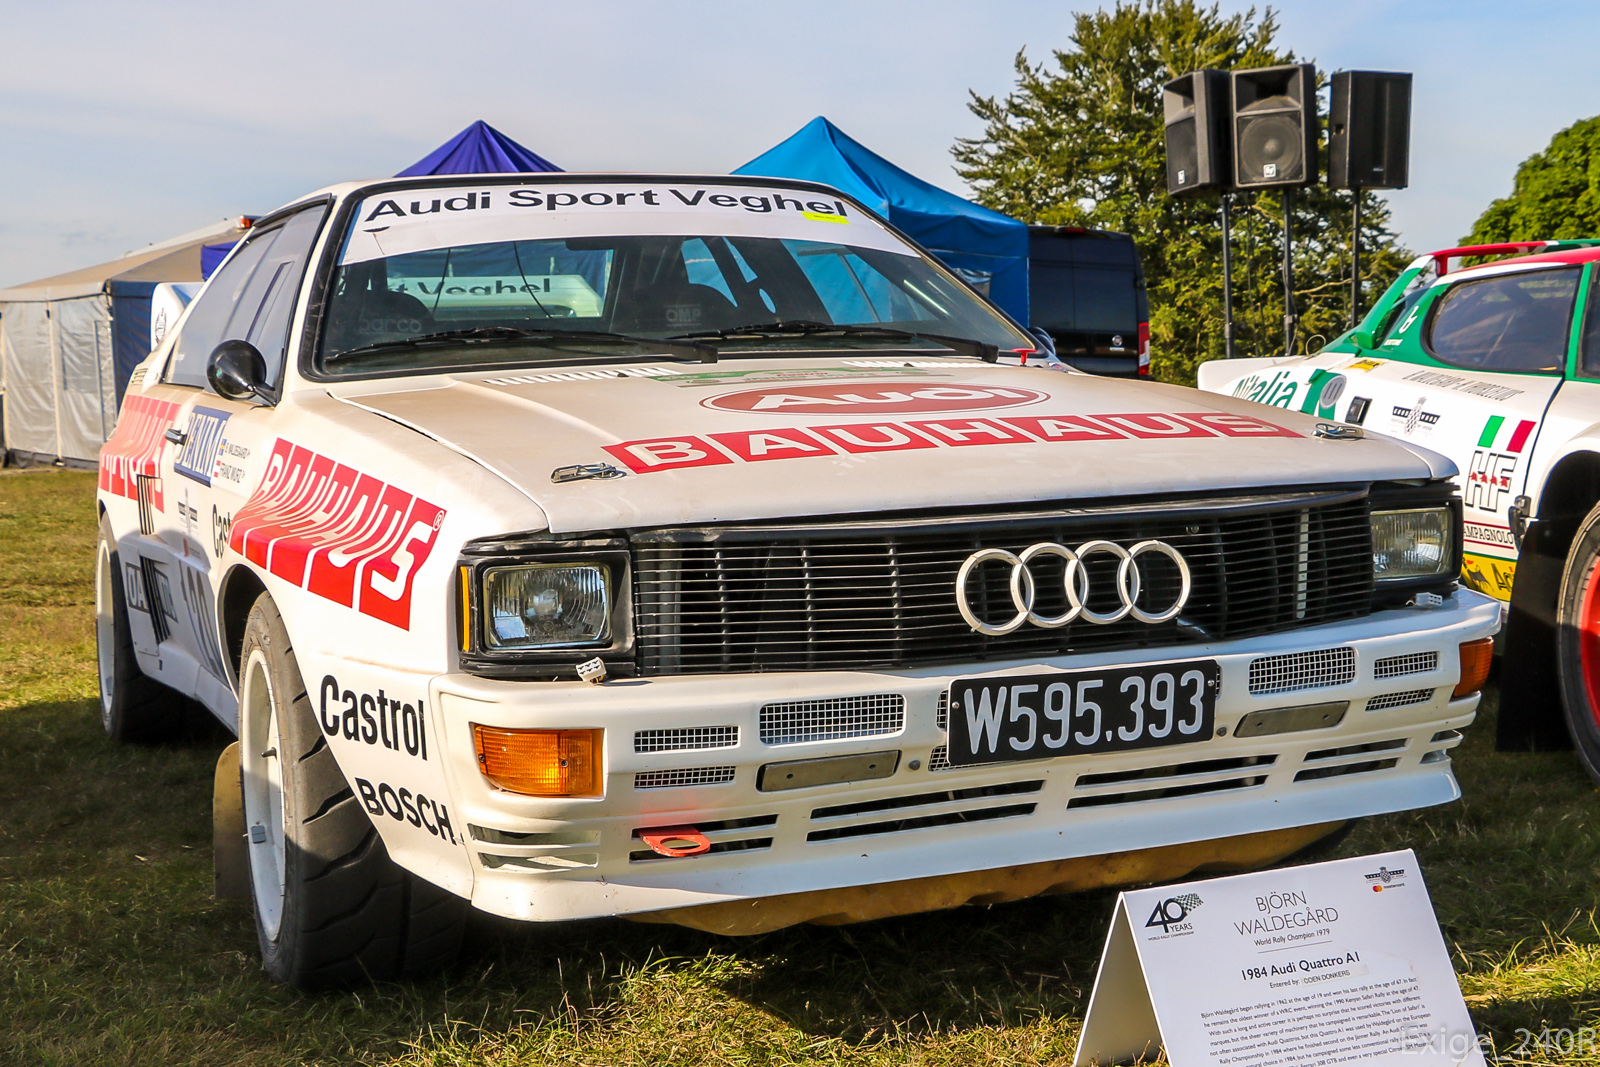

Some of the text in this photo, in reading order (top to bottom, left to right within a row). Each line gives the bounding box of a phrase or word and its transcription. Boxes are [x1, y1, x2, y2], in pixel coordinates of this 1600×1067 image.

[365, 189, 848, 222] Audi Sport Veghel
[622, 412, 1279, 470] BAUHAUS
[320, 674, 428, 761] Castrol
[963, 669, 1205, 756] W595.393
[354, 776, 457, 846] BOSCH
[1255, 891, 1307, 914] BJÖRN
[1169, 922, 1193, 933] YEARS
[1233, 907, 1339, 936] WALDEGÅRD
[1254, 928, 1331, 946] World Rally Champion 1979
[1241, 966, 1268, 981] 1984
[1270, 962, 1297, 976] Audi
[1298, 956, 1344, 972] Quattro
[1269, 979, 1291, 989] Entered
[1303, 976, 1321, 985] COEN
[1321, 969, 1351, 981] DONKERS
[1278, 1006, 1292, 1014] WRC
[1296, 1014, 1314, 1022] perhaps
[1324, 1016, 1351, 1026] campaigned
[1231, 1043, 1256, 1052] associated
[1318, 1029, 1337, 1037] Quattro
[1409, 1012, 1431, 1020] European
[1230, 1052, 1264, 1062] Championship
[1304, 1040, 1322, 1048] finished
[1322, 1037, 1339, 1045] second
